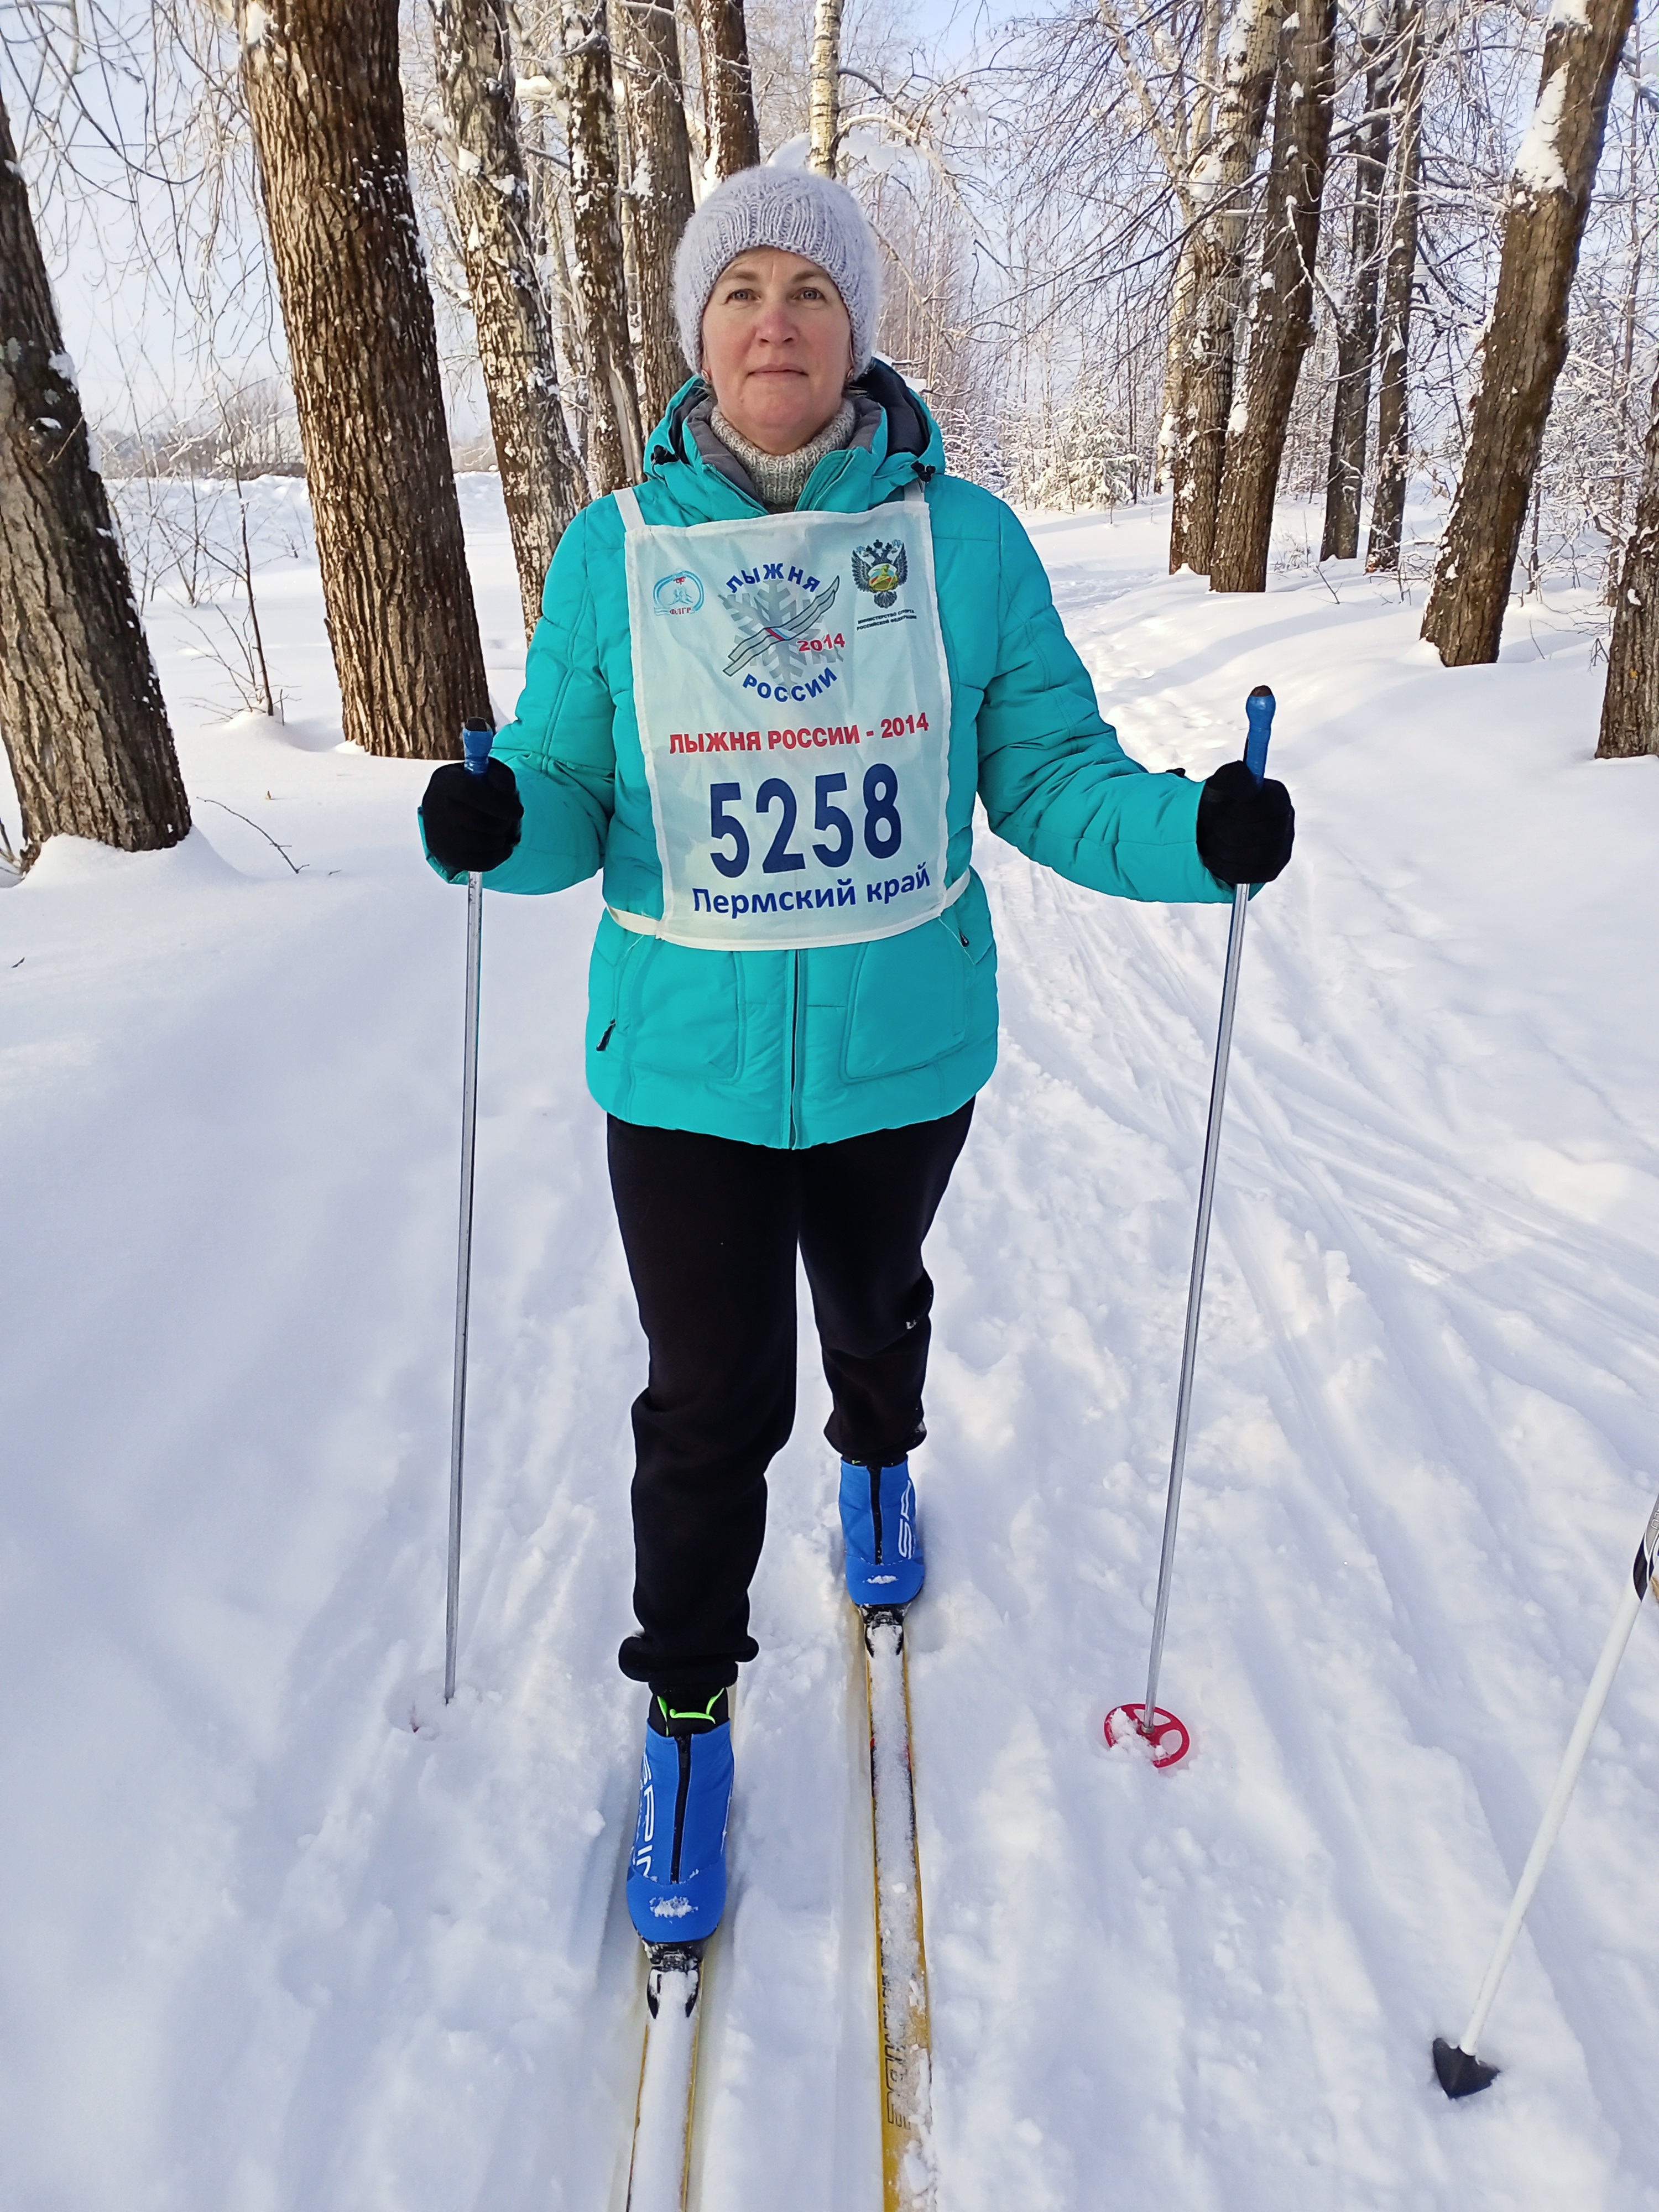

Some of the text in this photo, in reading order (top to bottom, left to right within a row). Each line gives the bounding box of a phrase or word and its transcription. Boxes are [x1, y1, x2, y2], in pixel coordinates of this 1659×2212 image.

[726, 563, 821, 593] ЛЫЖНЯ
[857, 619, 889, 630] РОССИЙСКОЙ
[858, 612, 896, 624] МИНИСТЕРСТВО
[797, 633, 845, 651] 2014
[742, 666, 838, 703] РОССИИ
[669, 732, 762, 754] ЛЫЖНЯ
[767, 724, 861, 750] РОССИИ
[881, 713, 929, 738] 2014
[709, 763, 902, 878] 5258
[692, 861, 931, 919] Пермский край
